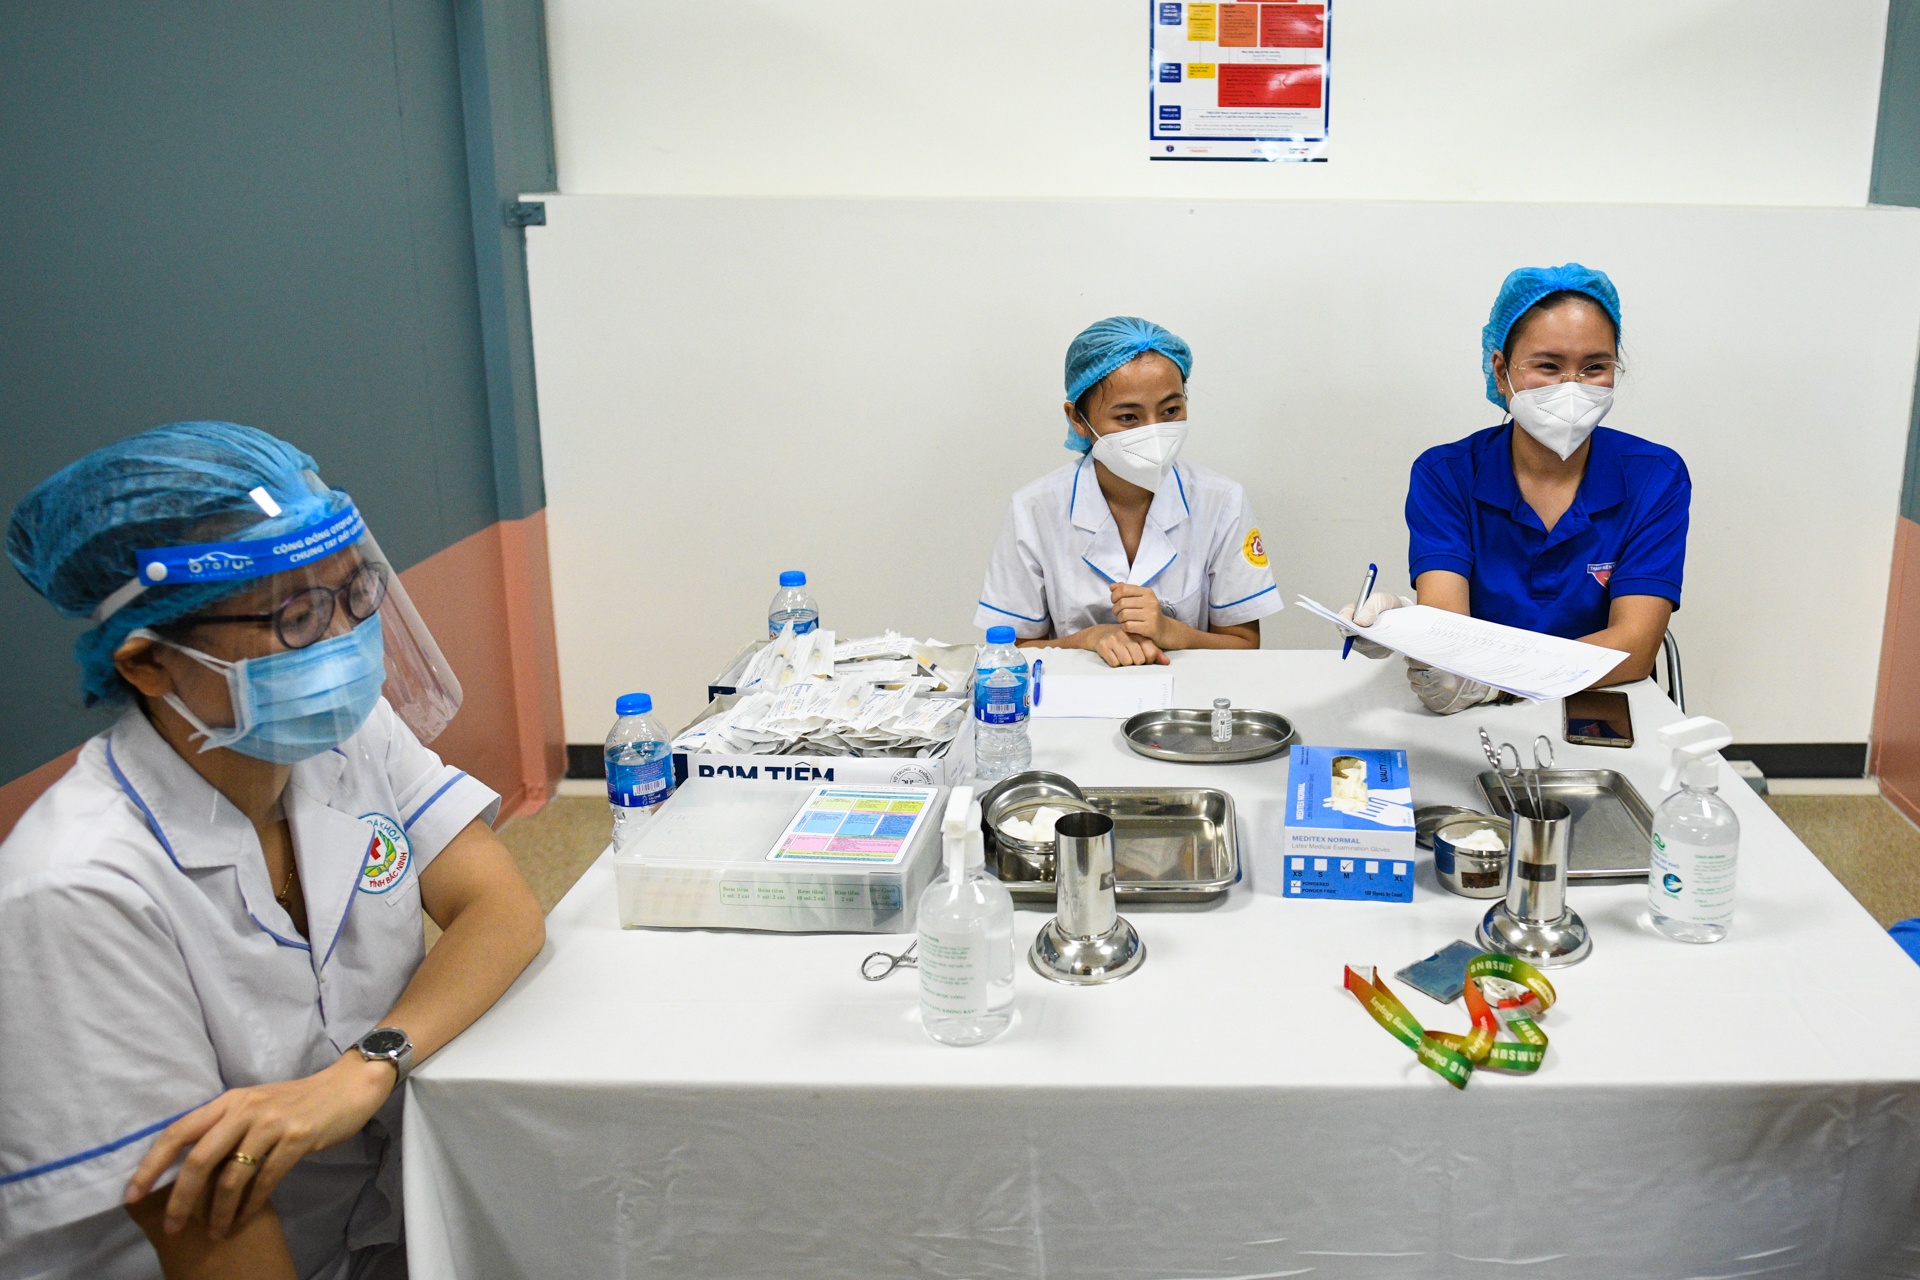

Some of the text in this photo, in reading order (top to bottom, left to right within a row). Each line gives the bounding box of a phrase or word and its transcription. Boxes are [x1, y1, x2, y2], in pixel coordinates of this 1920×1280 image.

[290, 545, 324, 562] CHUNG
[1380, 763, 1389, 783] QUALITY
[380, 823, 400, 843] KHOA
[1292, 835, 1326, 843] MEDITEX
[1370, 996, 1394, 1022] Display
[1490, 1048, 1543, 1062] SAMSUN
